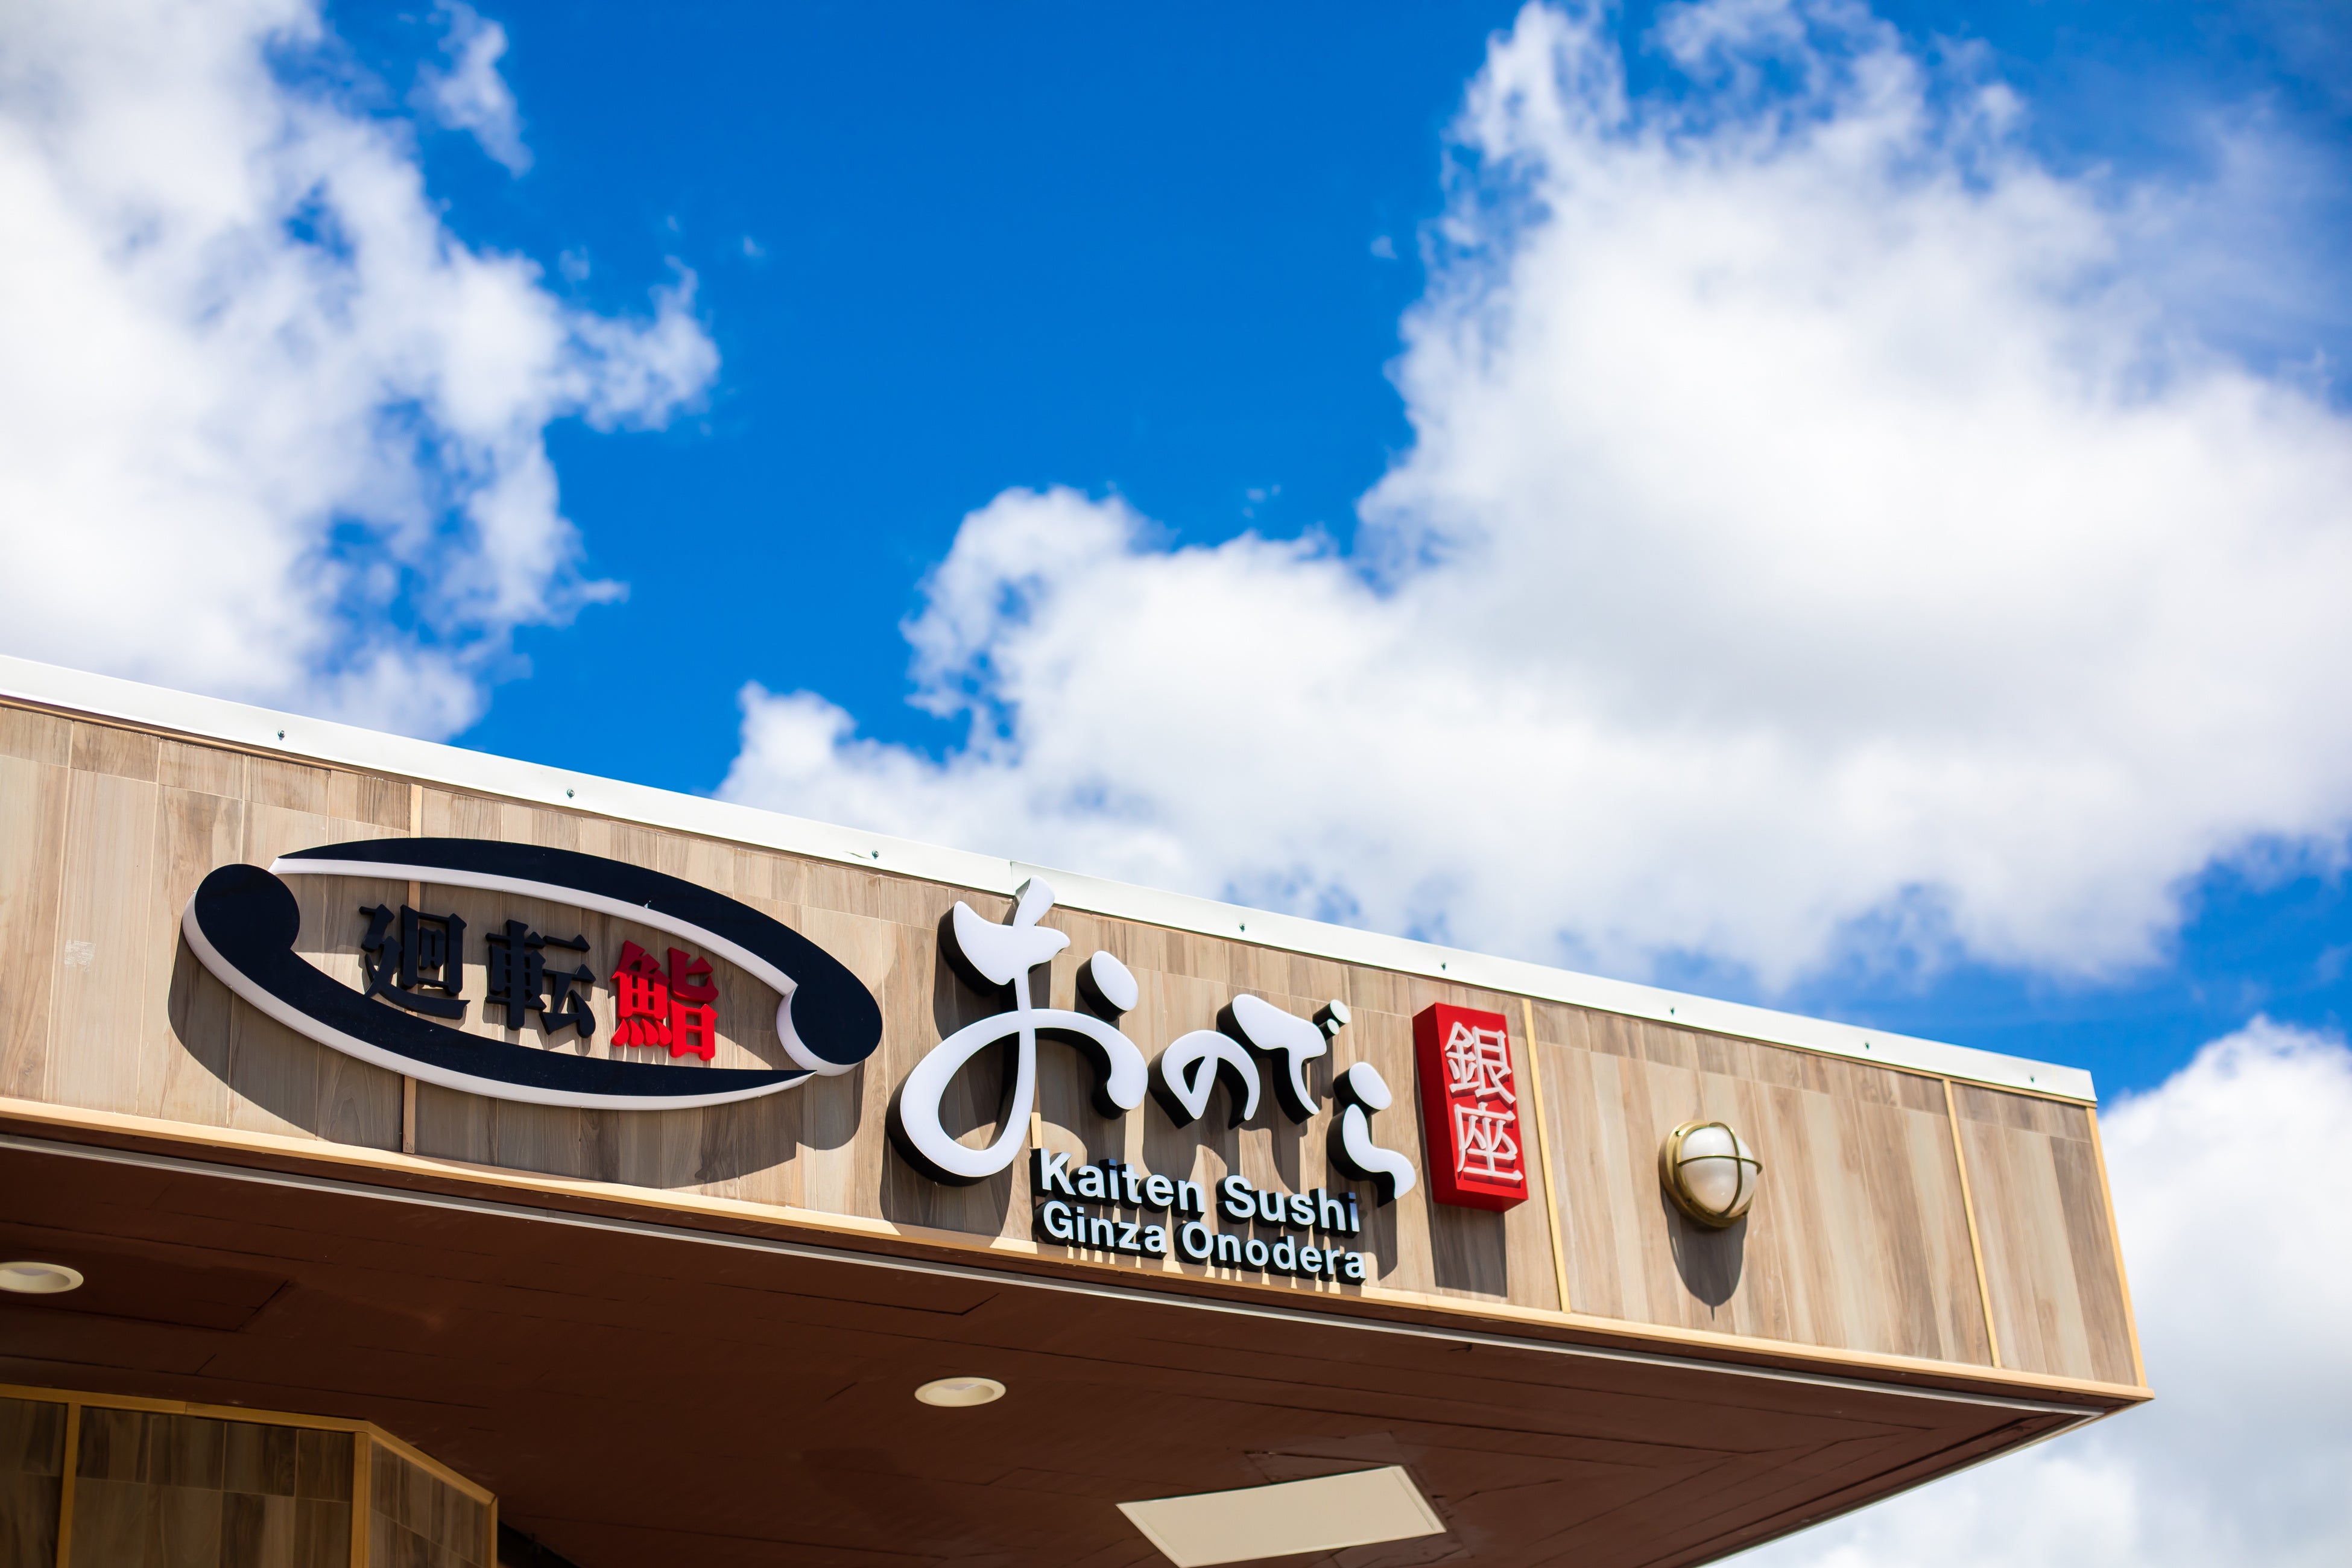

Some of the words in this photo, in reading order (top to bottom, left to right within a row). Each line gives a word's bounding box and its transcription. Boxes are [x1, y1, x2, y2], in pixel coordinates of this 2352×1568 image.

[359, 903, 719, 1061] 廻転鮨
[897, 877, 1417, 1200] おのでら
[1445, 1022, 1524, 1181] 銀座
[1040, 1148, 1206, 1213] Kaiten
[1224, 1175, 1360, 1233] Sushi
[1043, 1201, 1168, 1254] Ginza
[1181, 1221, 1366, 1279] Onodera
